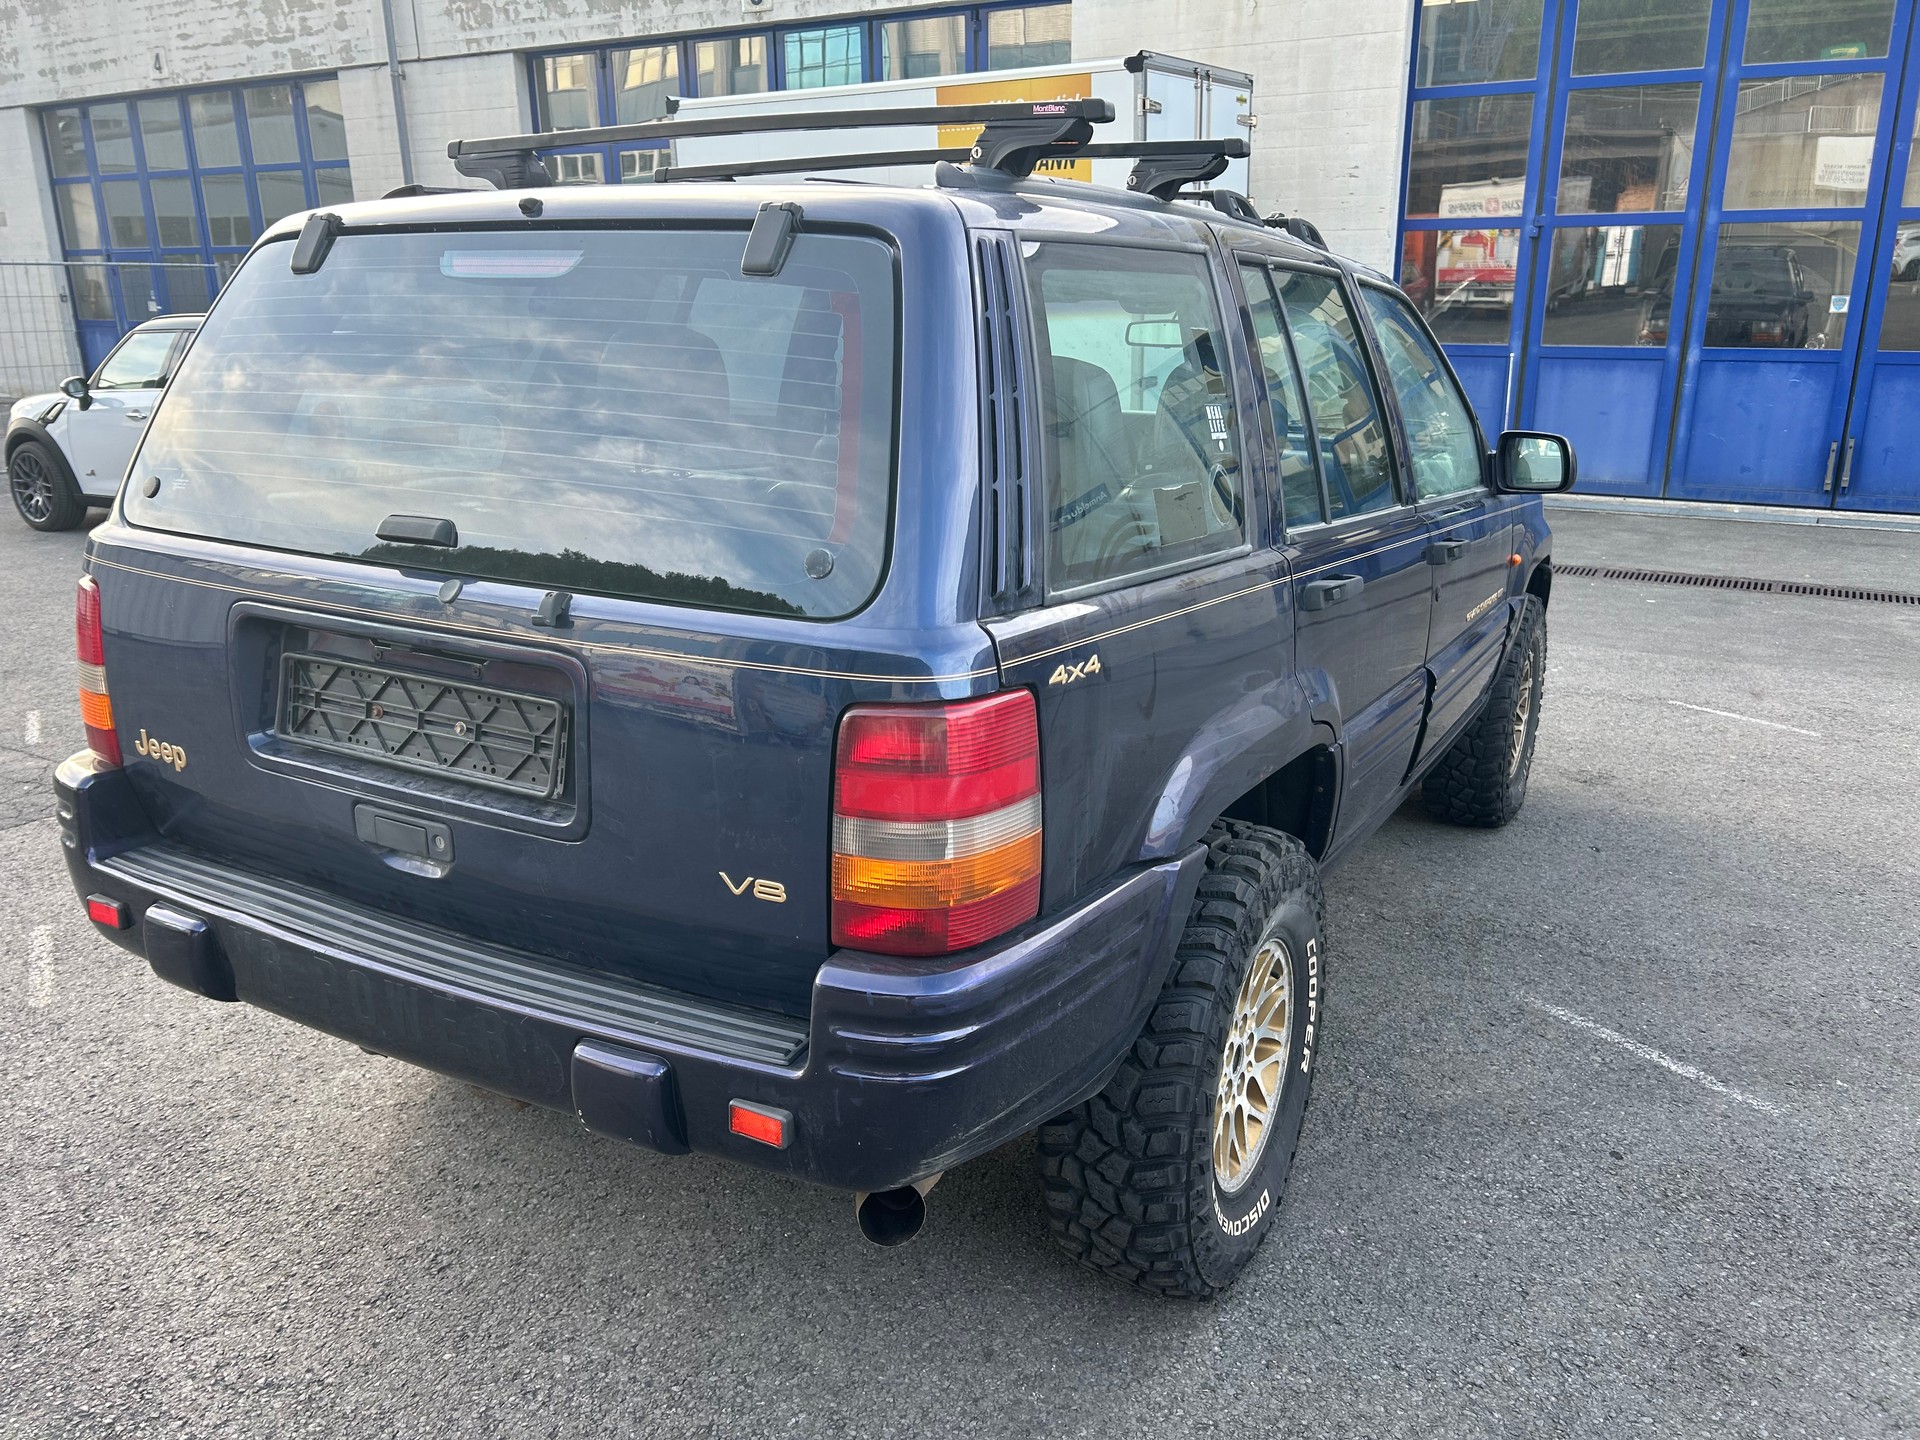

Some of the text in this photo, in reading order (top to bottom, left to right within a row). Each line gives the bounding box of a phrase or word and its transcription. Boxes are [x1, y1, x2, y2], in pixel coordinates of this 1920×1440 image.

[134, 728, 187, 773] Jeep
[719, 871, 787, 903] V8
[1300, 938, 1317, 1074] COOPER
